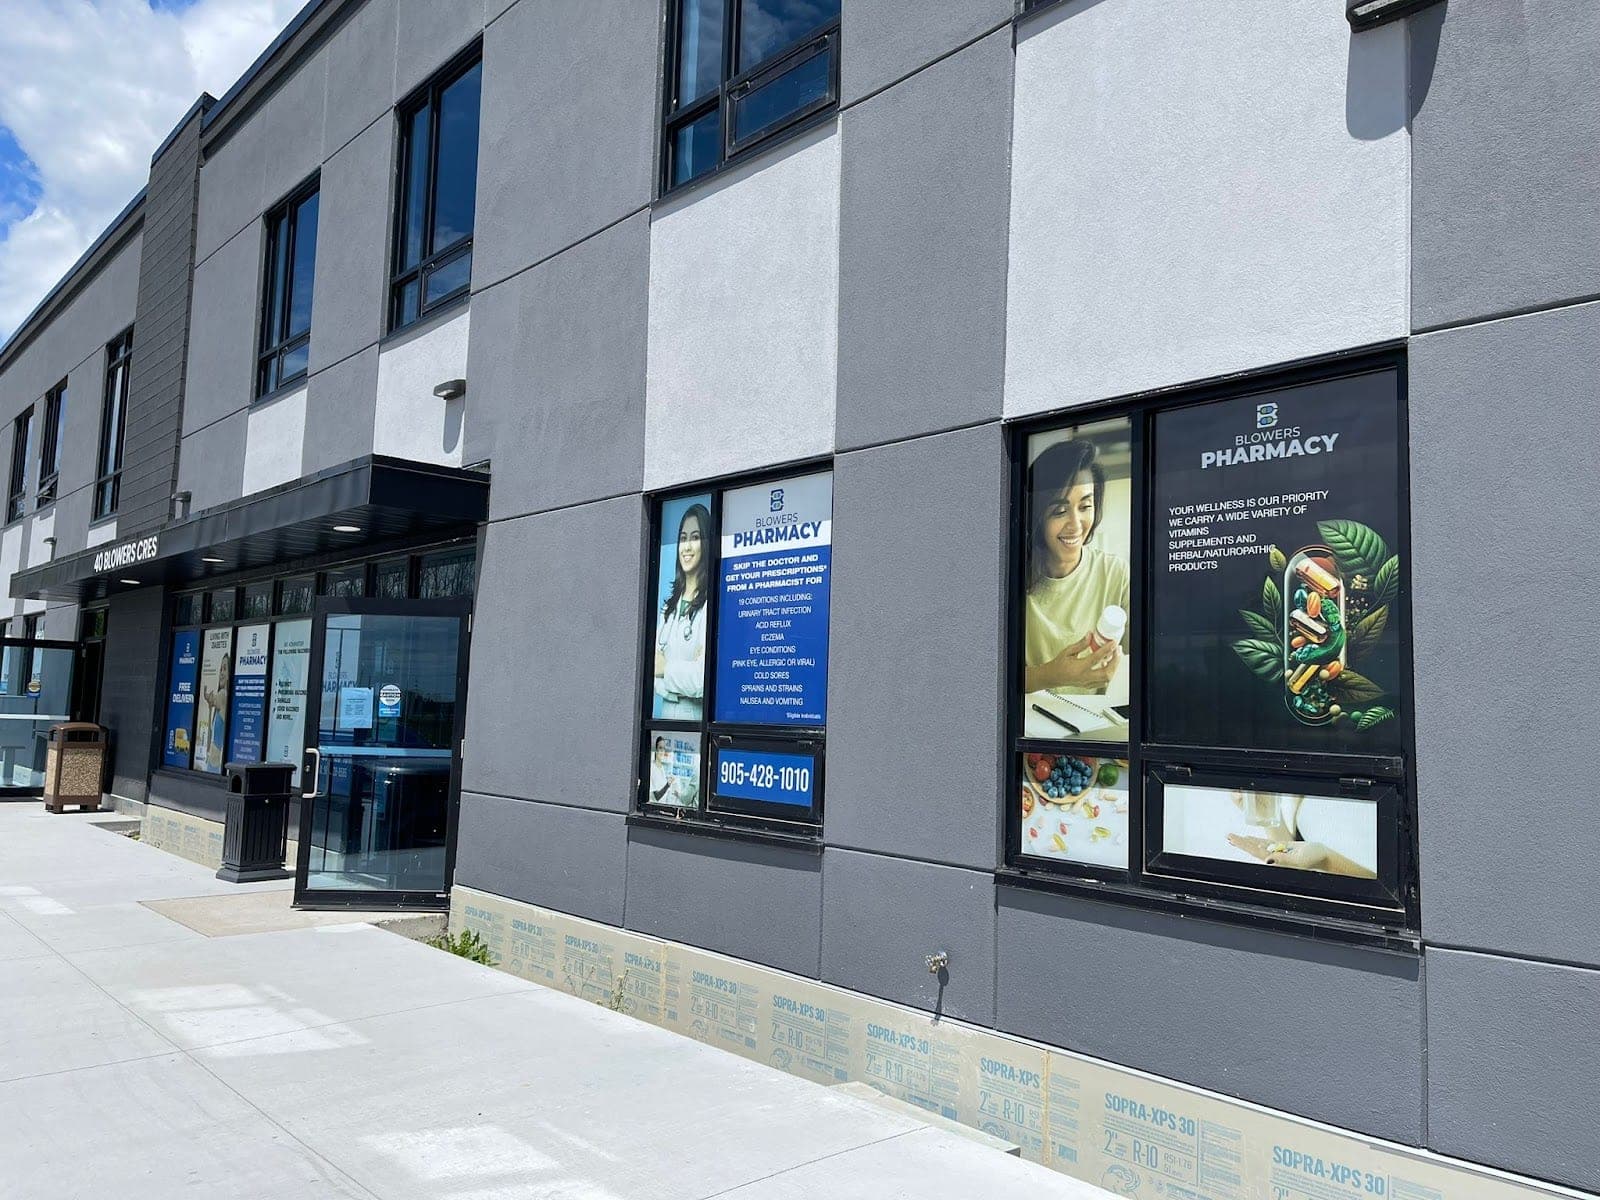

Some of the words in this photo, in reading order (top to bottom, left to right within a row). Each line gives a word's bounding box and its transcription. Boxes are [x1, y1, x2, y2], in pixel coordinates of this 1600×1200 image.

[1235, 426, 1301, 446] BLOWERS
[1201, 433, 1339, 468] PHARMACY
[1169, 505, 1194, 516] YOUR
[1195, 499, 1245, 513] WELLNESS
[1246, 498, 1256, 508] IS
[1257, 495, 1280, 506] OUR
[1281, 490, 1329, 504] PRIORITY
[756, 512, 799, 528] BLOWERS
[1169, 518, 1183, 527] WE
[1184, 514, 1215, 526] CARRY
[1216, 513, 1224, 522] A
[1225, 511, 1250, 522] WIDE
[1251, 506, 1291, 519] VARIETY
[1292, 504, 1308, 515] OF
[733, 521, 822, 548] PHARMACY
[1169, 526, 1209, 538] VITAMINS
[1169, 535, 1234, 550] SUPPLEMENTS
[1235, 534, 1257, 544] AND
[94, 553, 103, 572] 40
[103, 543, 136, 570] BLOWERS
[136, 535, 158, 561] CRES
[1169, 544, 1275, 561] HERBAL/NATUROPATHIC
[733, 561, 750, 571] SKIP
[752, 560, 766, 569] THE
[767, 556, 800, 567] DOCTOR
[801, 554, 819, 563] AND
[1169, 561, 1218, 573] PRODUCTS
[725, 573, 739, 582] GET
[740, 571, 760, 580] YOUR
[727, 582, 747, 592] FROM
[748, 582, 754, 590] A
[755, 578, 804, 590] PHARMACIST
[805, 577, 822, 585] FOR
[738, 598, 744, 606] 19
[745, 595, 778, 605] CONDITIONS
[779, 593, 813, 603] INCLUDING:
[738, 609, 761, 618] URINARY
[762, 607, 780, 616] TRACT
[781, 606, 812, 615] INFECTION
[755, 621, 769, 629] ACID
[770, 620, 791, 628] REFLUX
[761, 633, 785, 642] ECZEMA
[749, 646, 760, 654] EYE
[761, 646, 796, 654] CONDITIONS
[240, 655, 266, 666] PHARMACY
[732, 660, 746, 668] (PINK
[759, 658, 786, 667] ALLERGIC
[787, 658, 796, 666] OR
[797, 658, 815, 668] VIRAL)
[754, 671, 769, 679] COLD
[770, 671, 790, 680] SORES
[741, 684, 764, 692] SPRAINS
[765, 684, 777, 692] AND
[778, 684, 803, 692] STRAINS
[740, 697, 761, 705] NAUSEA
[762, 697, 774, 705] AND
[775, 697, 804, 706] VOMITING
[721, 761, 809, 793] 905-428-1010
[692, 970, 728, 992] SOPRA-XPS
[728, 982, 737, 995] 30
[773, 994, 814, 1019] SOPRA-XPS
[815, 1008, 825, 1022] 30
[867, 1023, 916, 1051] SOPRA-XPS
[917, 1038, 929, 1055] 30
[980, 1056, 1040, 1089] SOPRA-XPS
[1003, 1098, 1025, 1125] R-10
[1105, 1092, 1177, 1131] SOPRA-XPS
[1178, 1116, 1196, 1137] 30
[1132, 1138, 1158, 1169] R-10
[1272, 1145, 1361, 1189] SOPRA-XPS
[1364, 1172, 1385, 1196] 30
